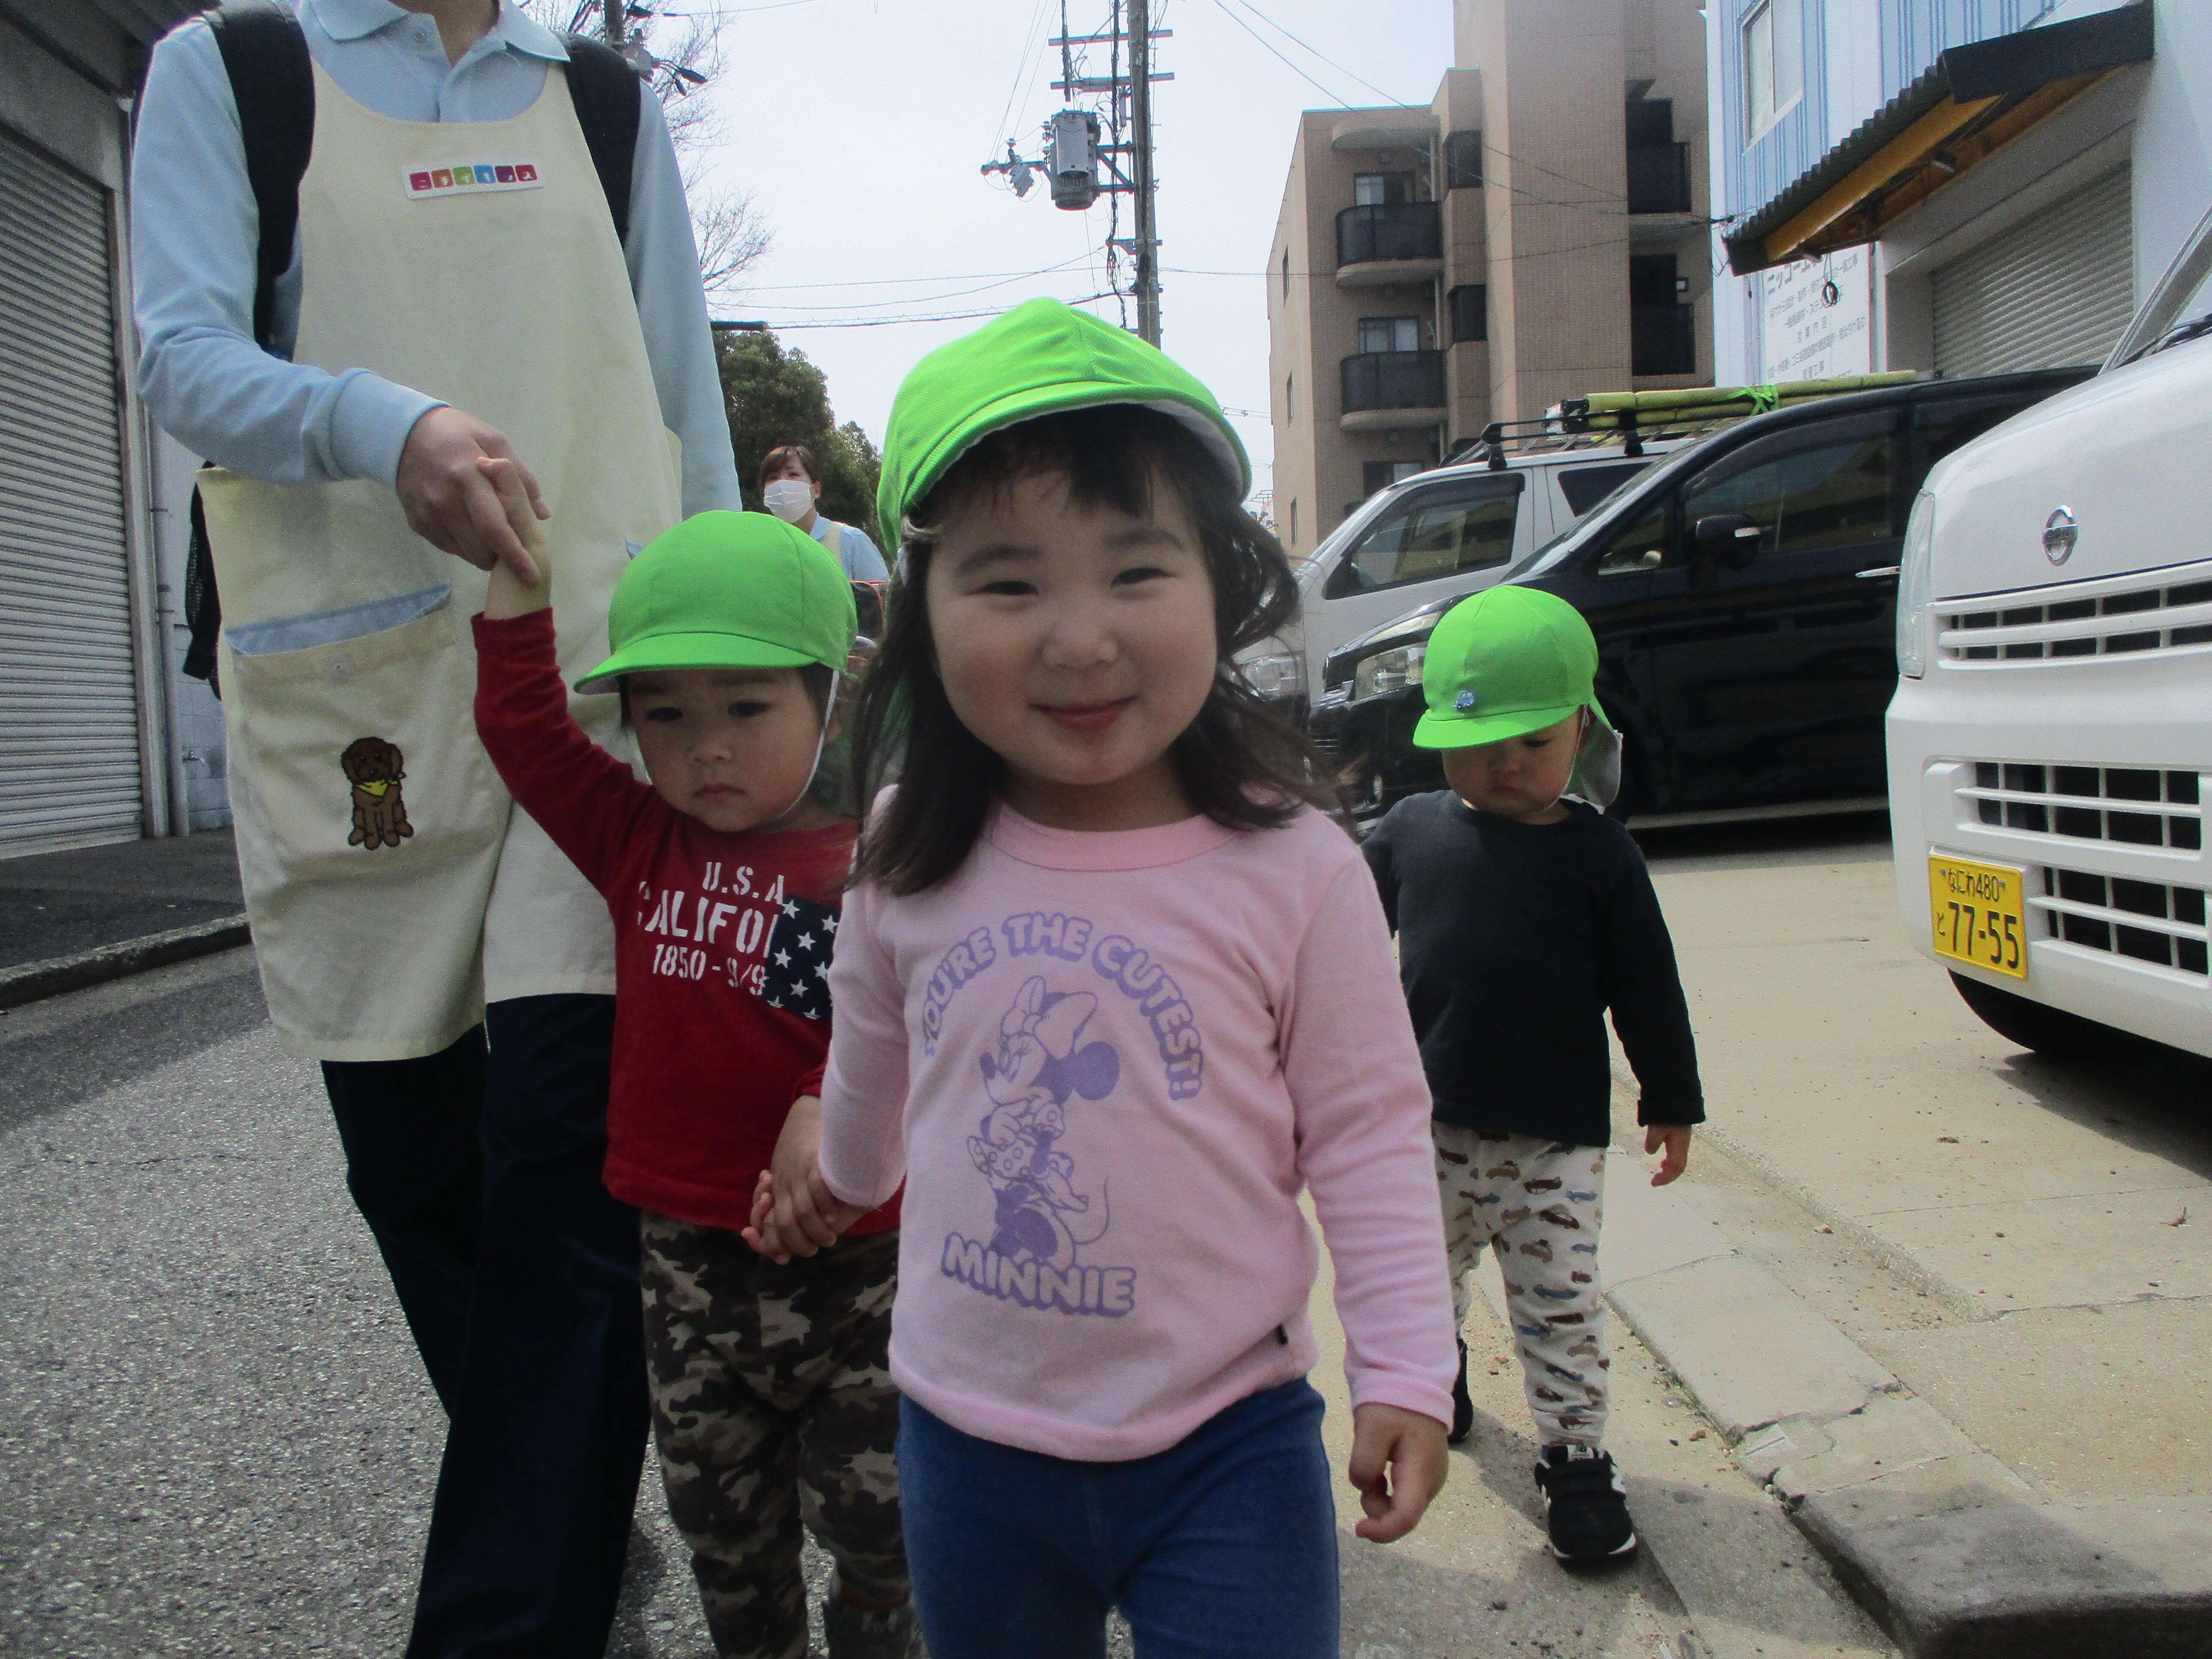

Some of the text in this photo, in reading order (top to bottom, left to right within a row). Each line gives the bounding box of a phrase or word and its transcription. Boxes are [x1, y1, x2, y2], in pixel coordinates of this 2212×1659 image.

[637, 881, 778, 958] ALIFO
[1948, 900, 2018, 969] 77-55
[1002, 911, 1093, 962] THE
[1091, 934, 1202, 1101] CUTEST!
[941, 1231, 1137, 1318] MINNIE
